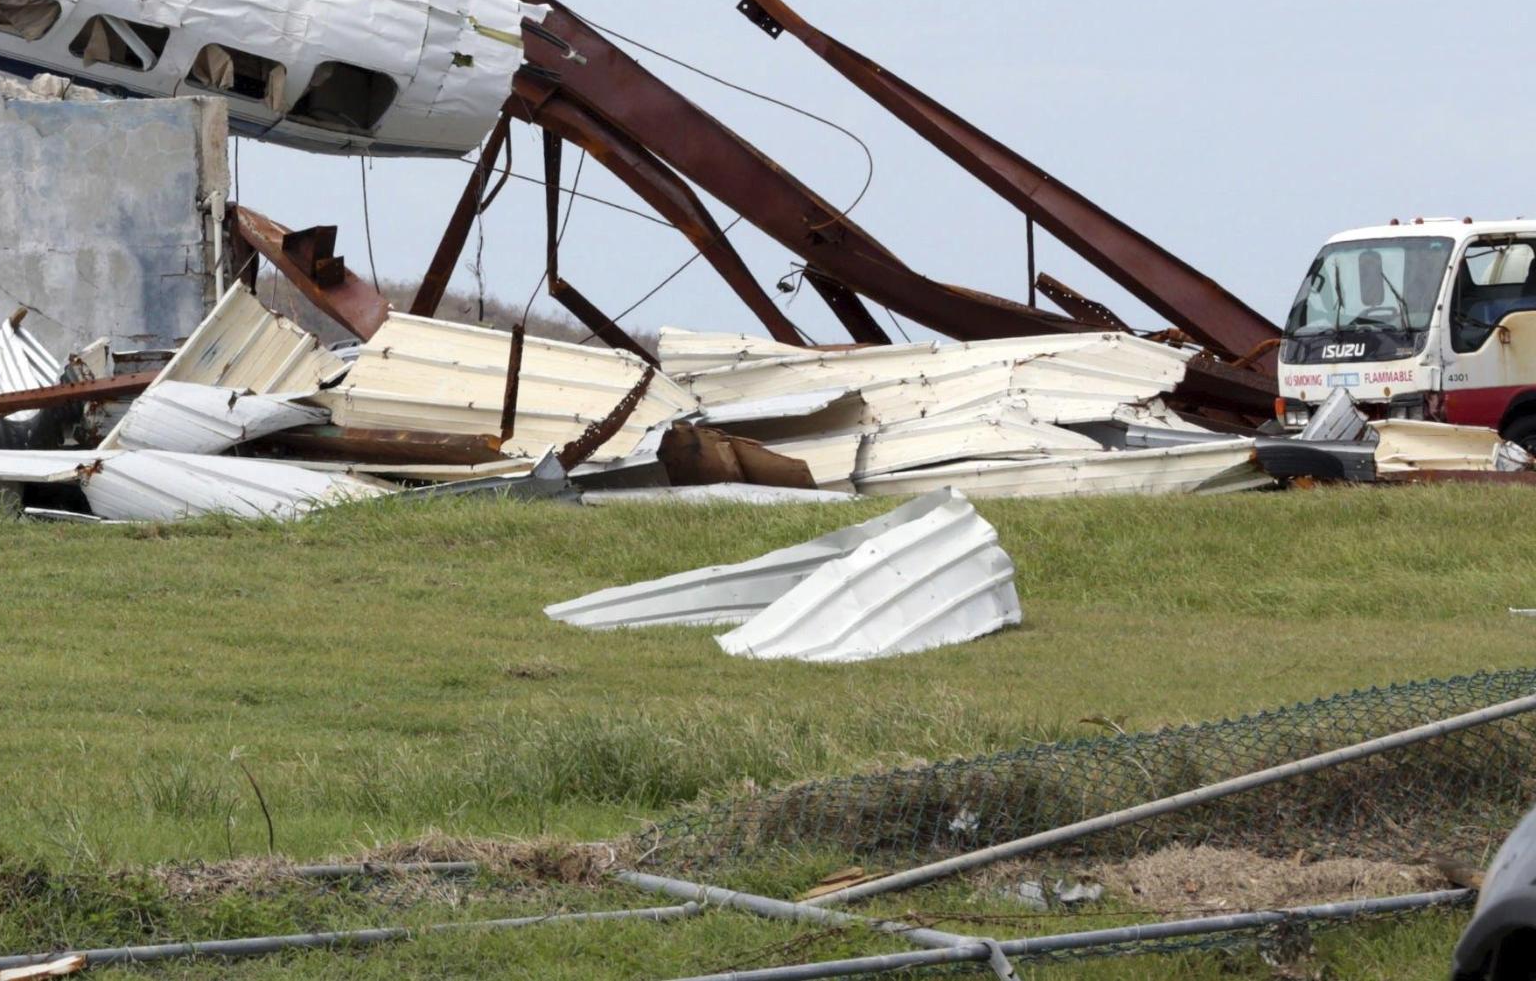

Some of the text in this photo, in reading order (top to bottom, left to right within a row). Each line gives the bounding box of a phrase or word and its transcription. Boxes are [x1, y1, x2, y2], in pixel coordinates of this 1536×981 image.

[1322, 343, 1366, 359] ISUZU
[1293, 374, 1323, 387] SMOKING
[1365, 370, 1414, 384] FLAMMABLE
